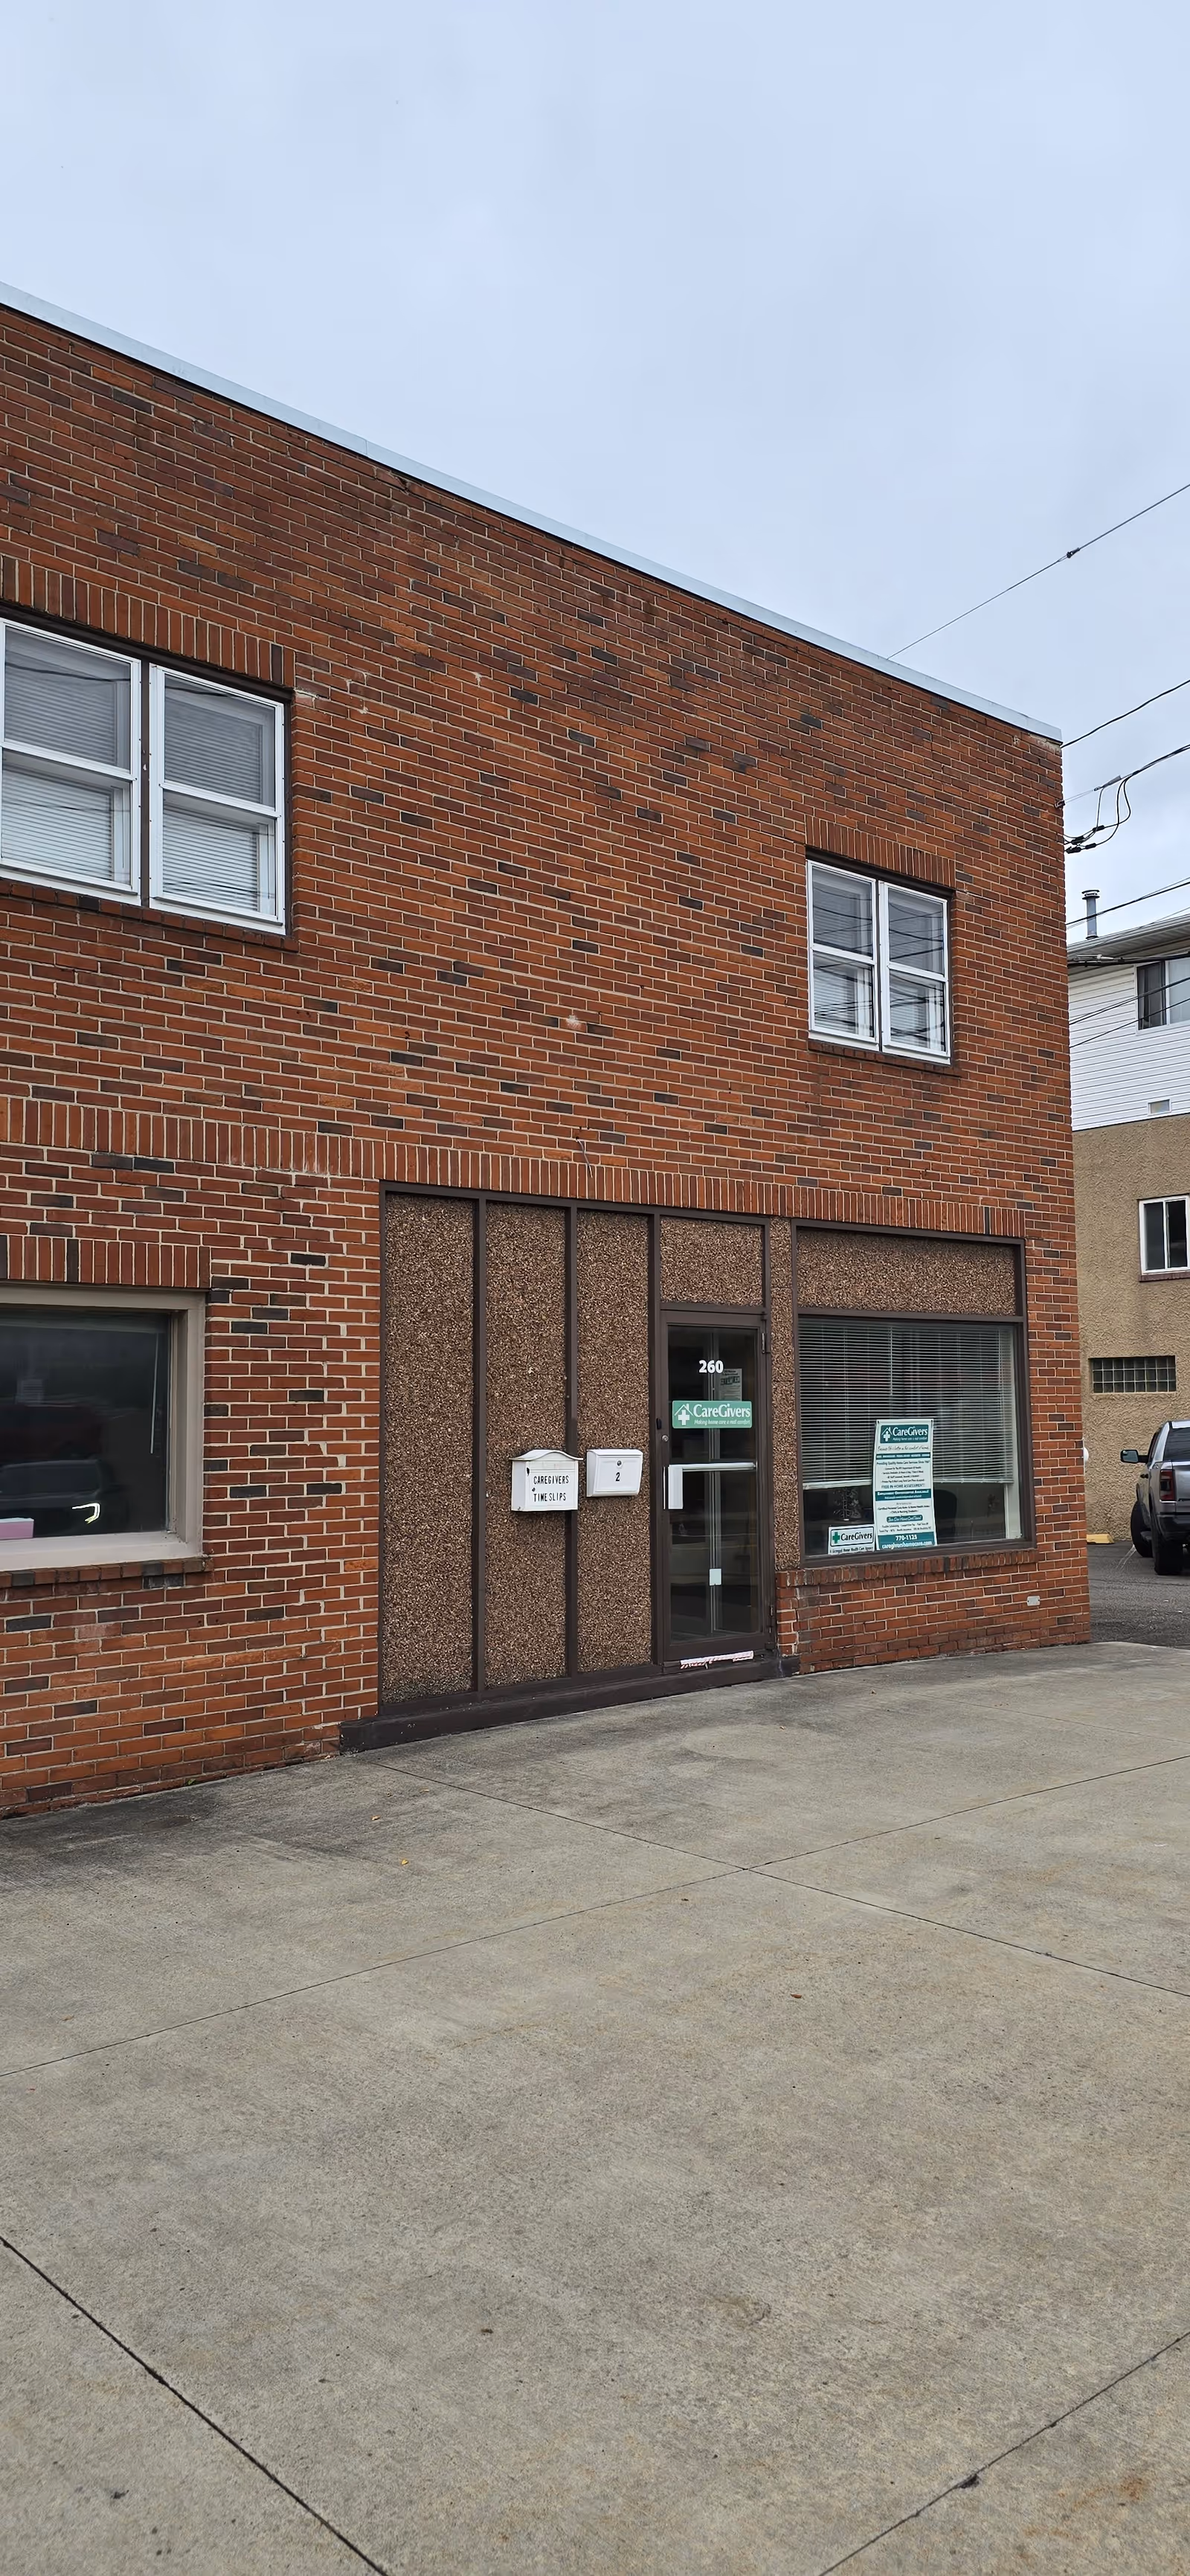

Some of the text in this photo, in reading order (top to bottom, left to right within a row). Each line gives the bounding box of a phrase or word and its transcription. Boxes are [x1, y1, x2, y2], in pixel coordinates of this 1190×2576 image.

[698, 1360, 724, 1374] 260
[693, 1403, 750, 1418] CareGivers
[892, 1426, 927, 1436] CareGivers
[533, 1475, 570, 1485] CAREGIVERS
[615, 1472, 620, 1482] 2
[533, 1492, 567, 1503] TIME SLIPS
[840, 1532, 872, 1541] CareGivers
